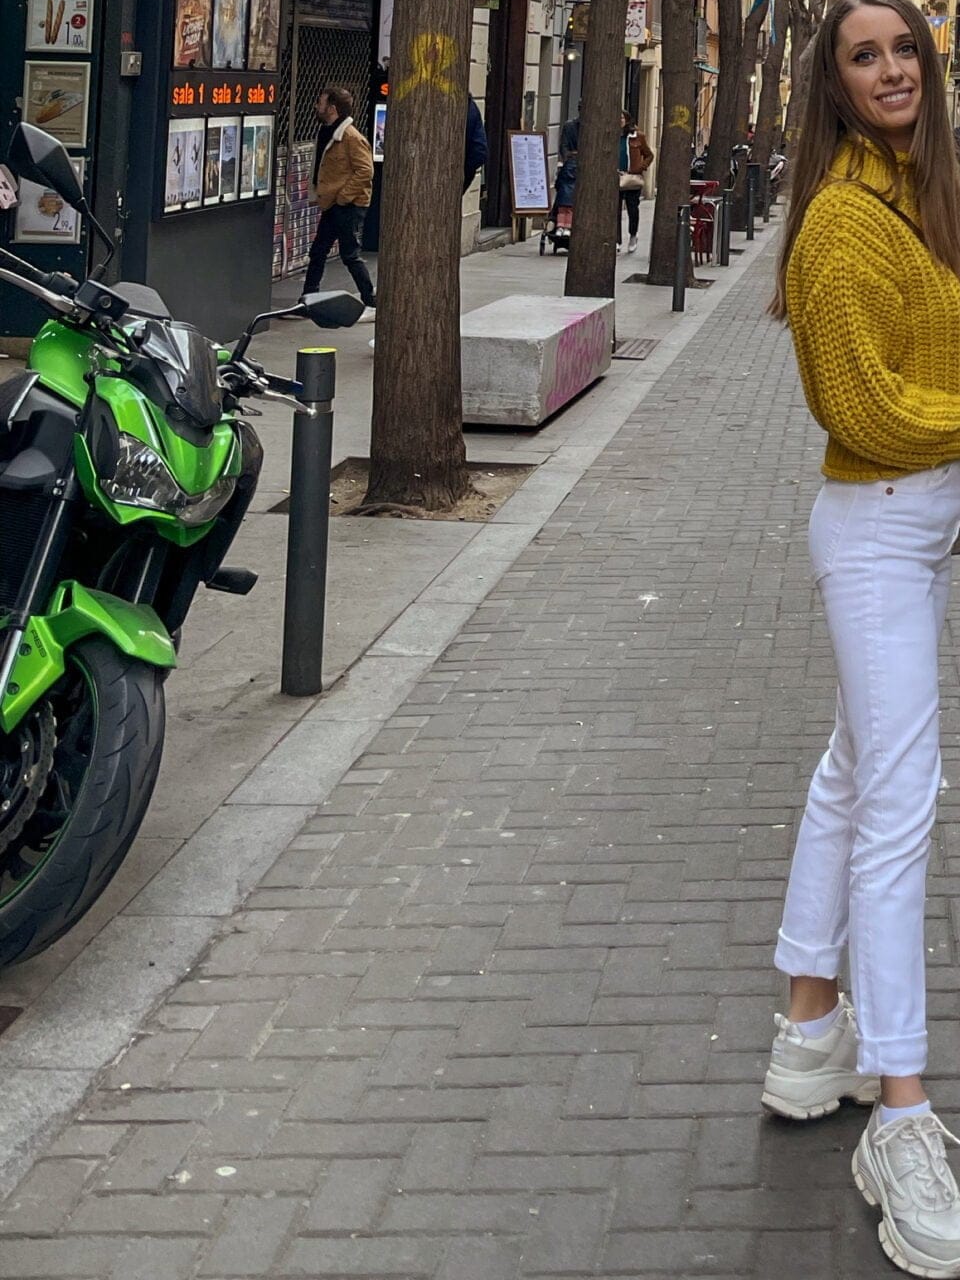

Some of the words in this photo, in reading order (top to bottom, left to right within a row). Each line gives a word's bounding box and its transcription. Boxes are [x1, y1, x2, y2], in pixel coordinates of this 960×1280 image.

[173, 82, 194, 105] sala
[199, 82, 205, 104] 1
[212, 82, 231, 104] sala
[235, 83, 242, 104] 2
[247, 83, 265, 104] sala
[268, 83, 275, 104] 3
